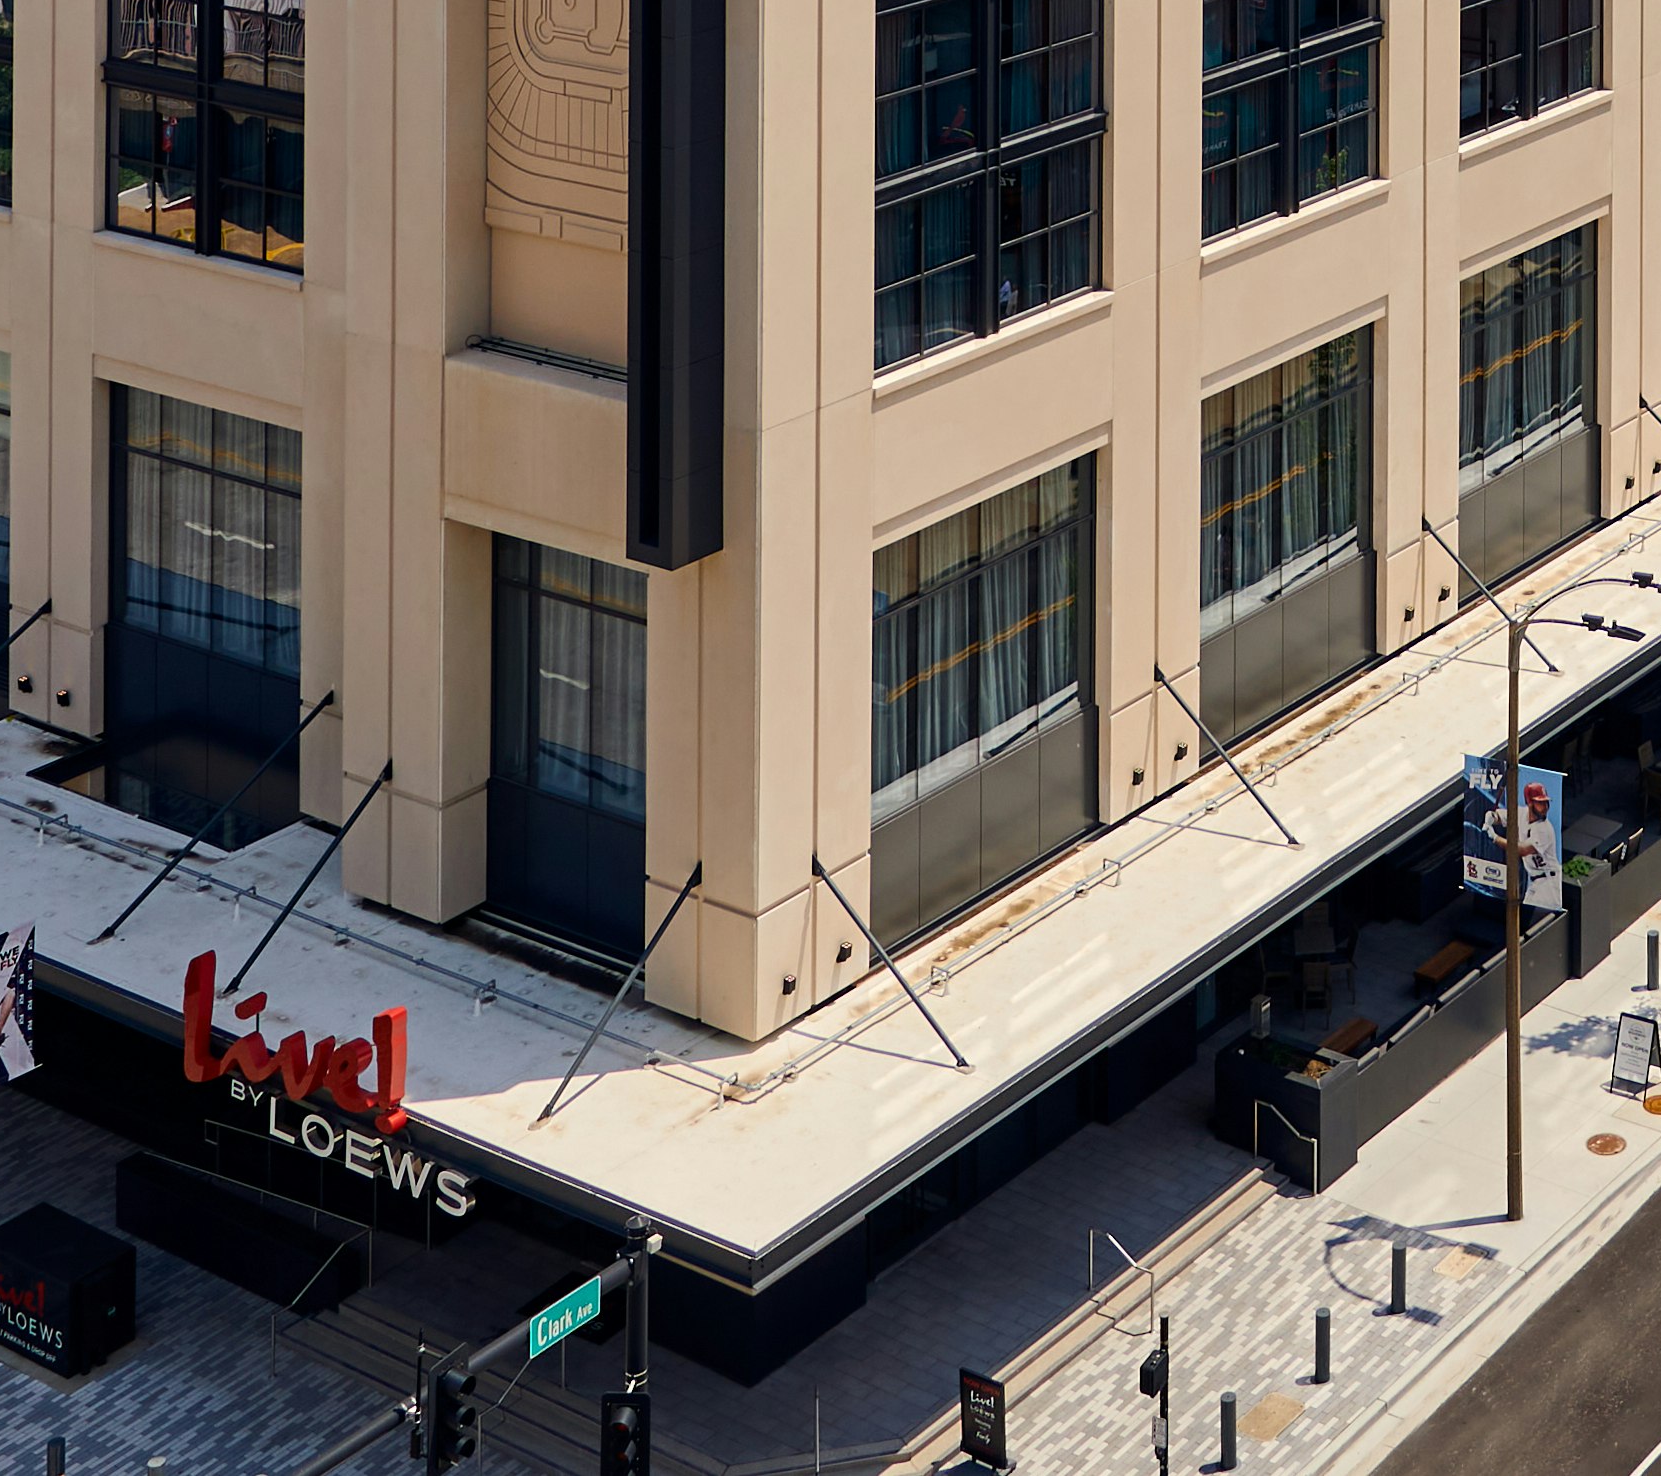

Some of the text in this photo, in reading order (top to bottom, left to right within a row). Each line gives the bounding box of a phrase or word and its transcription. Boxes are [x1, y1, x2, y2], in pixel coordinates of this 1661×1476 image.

[1469, 773, 1503, 790] FLY
[1532, 854, 1546, 868] 12
[0, 945, 19, 960] WE
[0, 957, 19, 971] FLY
[183, 949, 408, 1135] Live!
[230, 1079, 476, 1217] BY LOEWS
[8, 1306, 63, 1348] LOEWS
[537, 1307, 573, 1346] Clark
[577, 1302, 593, 1321] Ave
[970, 1389, 995, 1408] Live!
